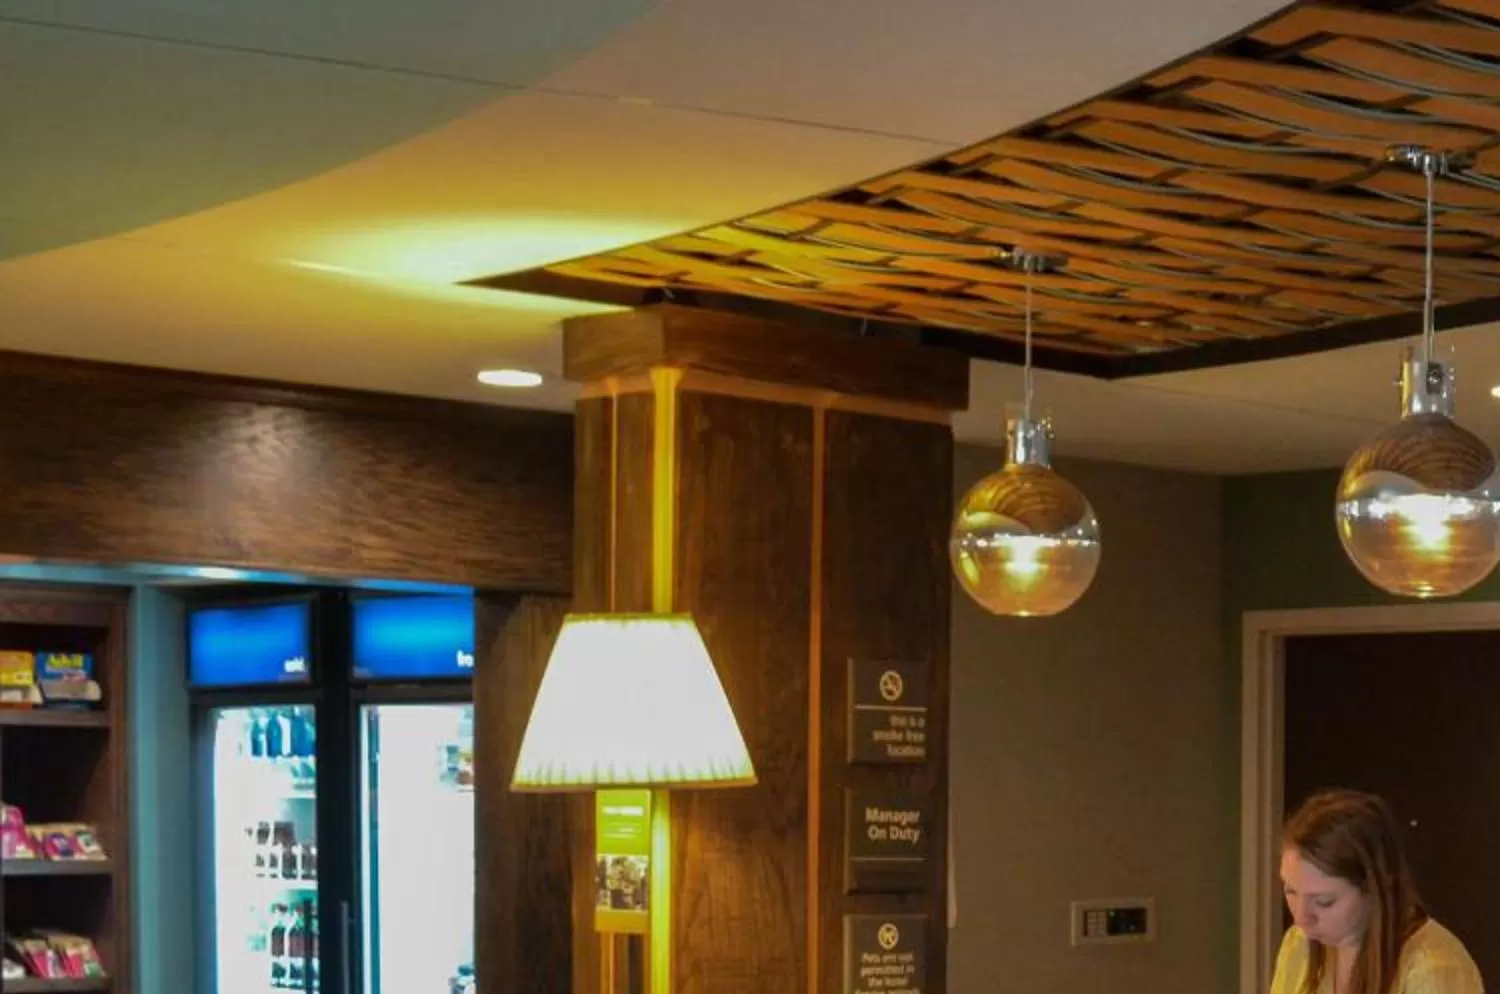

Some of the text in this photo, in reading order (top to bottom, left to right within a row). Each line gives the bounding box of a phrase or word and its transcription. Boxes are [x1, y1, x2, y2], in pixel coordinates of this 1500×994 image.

[865, 807, 920, 826] Manager
[867, 825, 920, 845] On Duty
